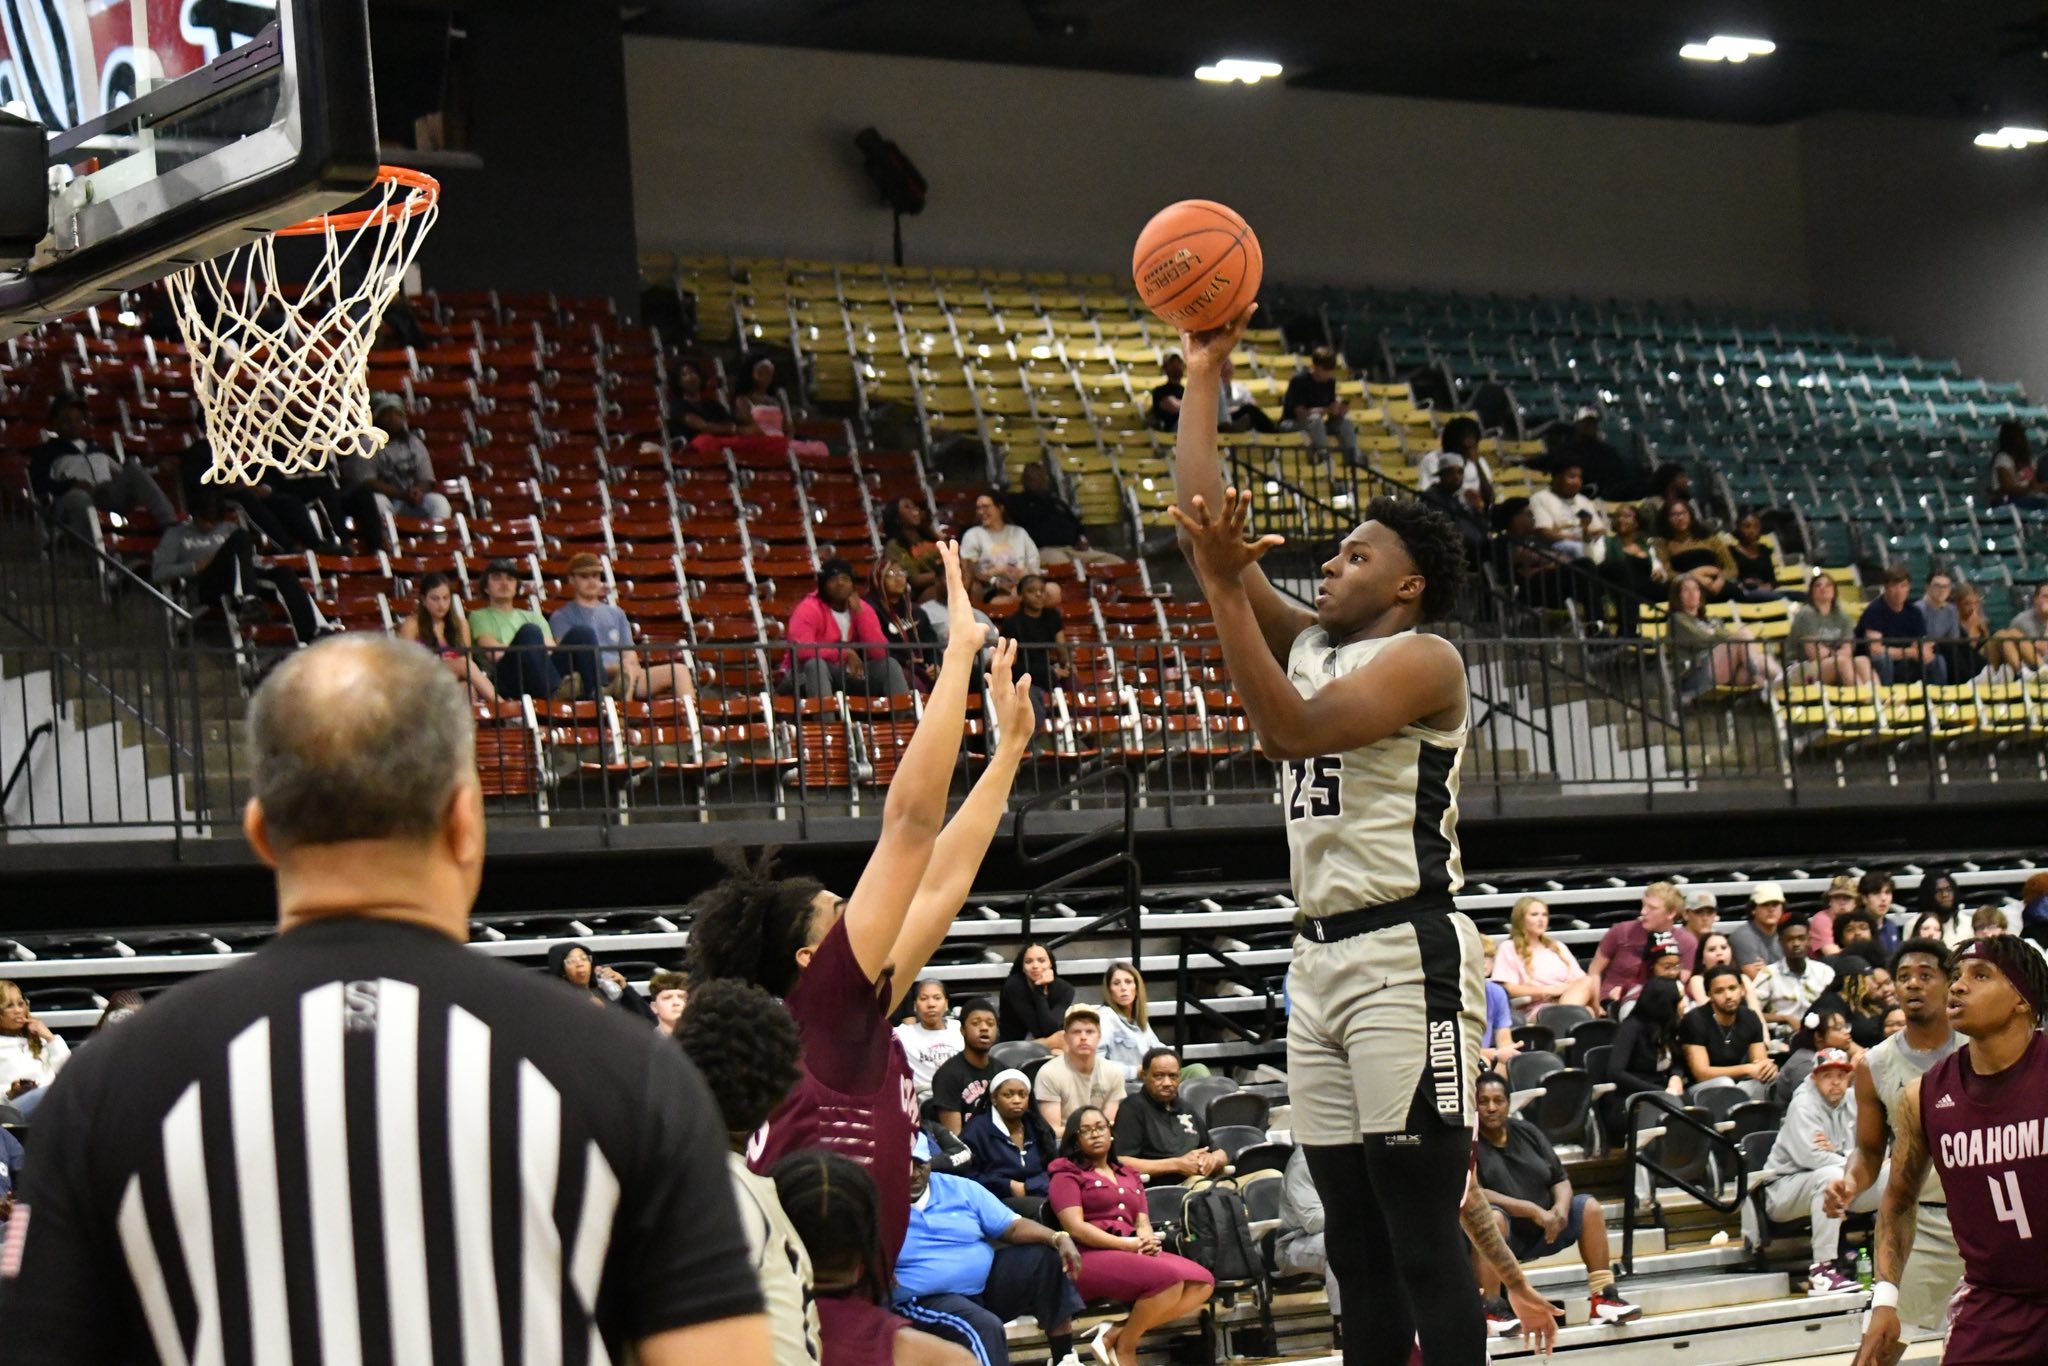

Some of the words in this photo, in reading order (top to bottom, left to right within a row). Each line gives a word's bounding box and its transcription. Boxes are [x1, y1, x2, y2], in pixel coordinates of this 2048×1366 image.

[1287, 754, 1345, 822] 25
[1429, 1020, 1460, 1113] BULLDOGS
[1987, 1170, 2033, 1239] 4
